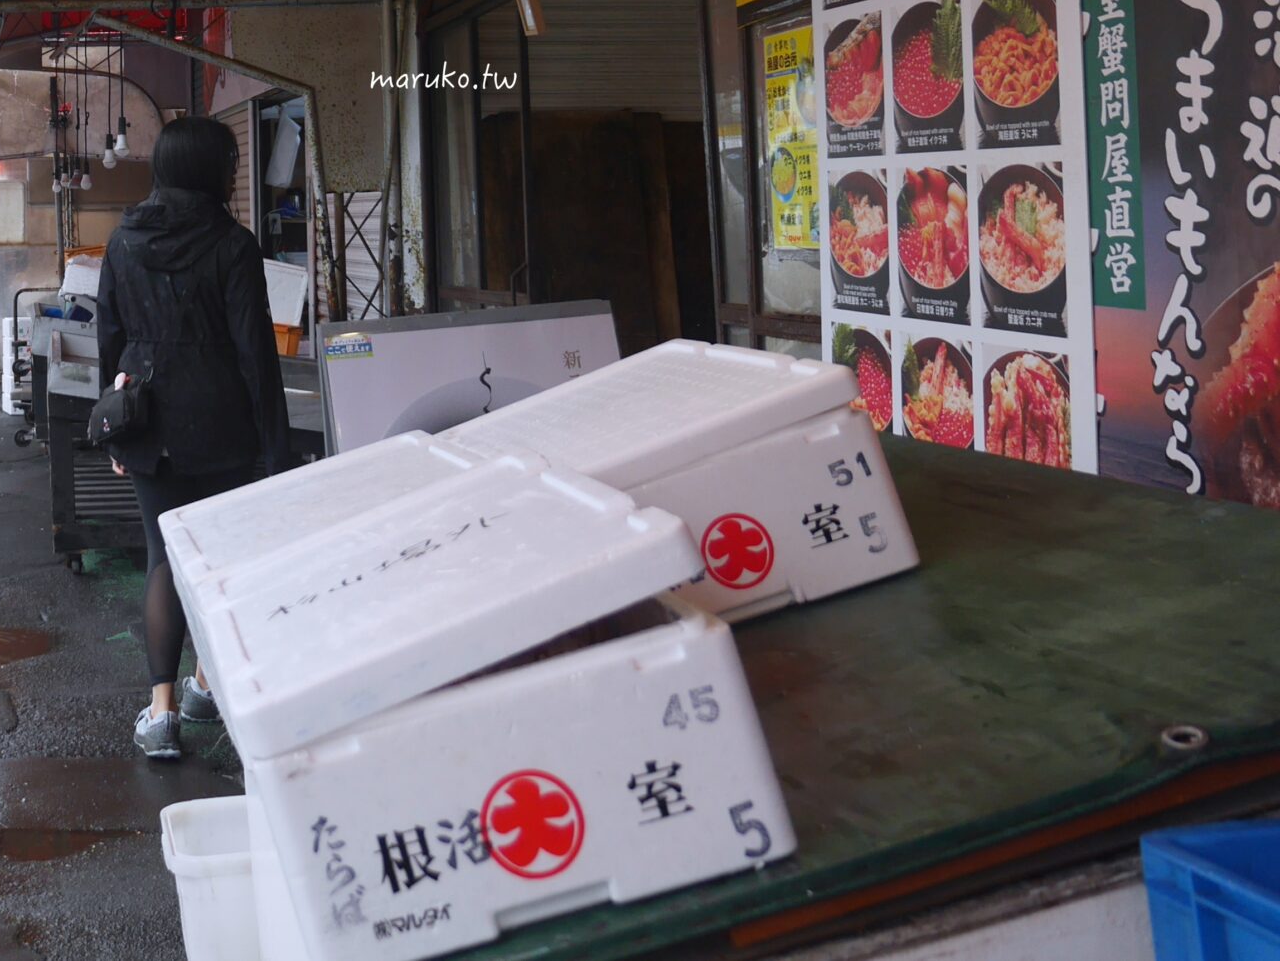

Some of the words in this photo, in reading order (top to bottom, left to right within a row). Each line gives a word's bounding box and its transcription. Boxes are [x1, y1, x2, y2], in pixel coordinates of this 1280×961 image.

[827, 451, 873, 487] 51
[802, 503, 849, 549] 室
[858, 512, 888, 553] 5
[662, 684, 721, 730] 45
[627, 760, 695, 828] 室
[728, 800, 772, 859] 5
